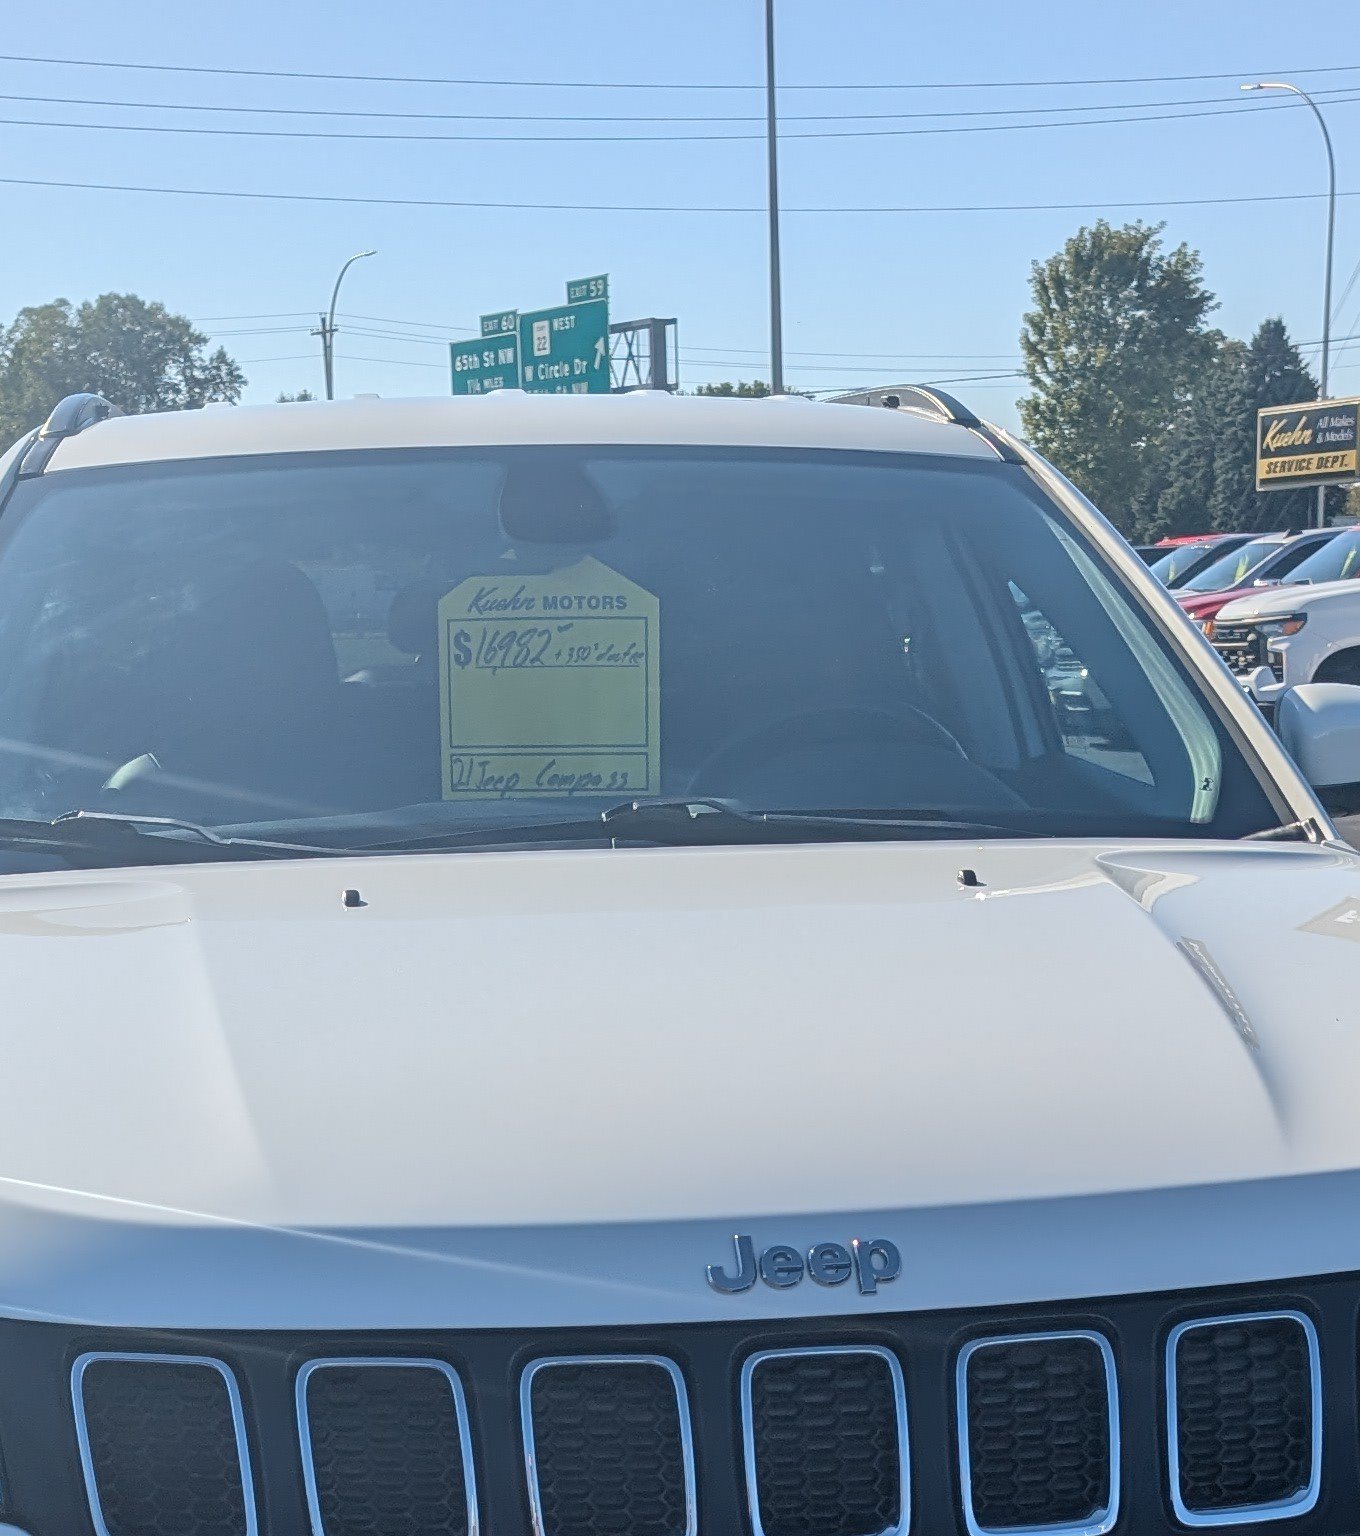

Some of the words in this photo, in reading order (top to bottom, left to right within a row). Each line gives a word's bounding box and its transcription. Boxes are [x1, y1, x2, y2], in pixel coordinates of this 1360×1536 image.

[569, 285, 588, 299] EXIT
[589, 280, 605, 297] 59
[501, 314, 515, 331] 60
[552, 315, 576, 331] WEST
[454, 354, 480, 372] 65th
[482, 351, 495, 368] St
[497, 347, 515, 365] NW
[524, 365, 534, 382] W
[537, 361, 570, 381] Circle
[573, 358, 588, 375] Dr
[1262, 415, 1313, 452] Kuehn
[1265, 457, 1314, 475] SERVICE
[1316, 453, 1348, 470] DEPT.
[467, 584, 537, 615] Kuehn
[542, 595, 628, 611] MOTORS
[475, 760, 520, 797] Jeep
[535, 758, 629, 796] Compass
[705, 1234, 903, 1296] Jeep
